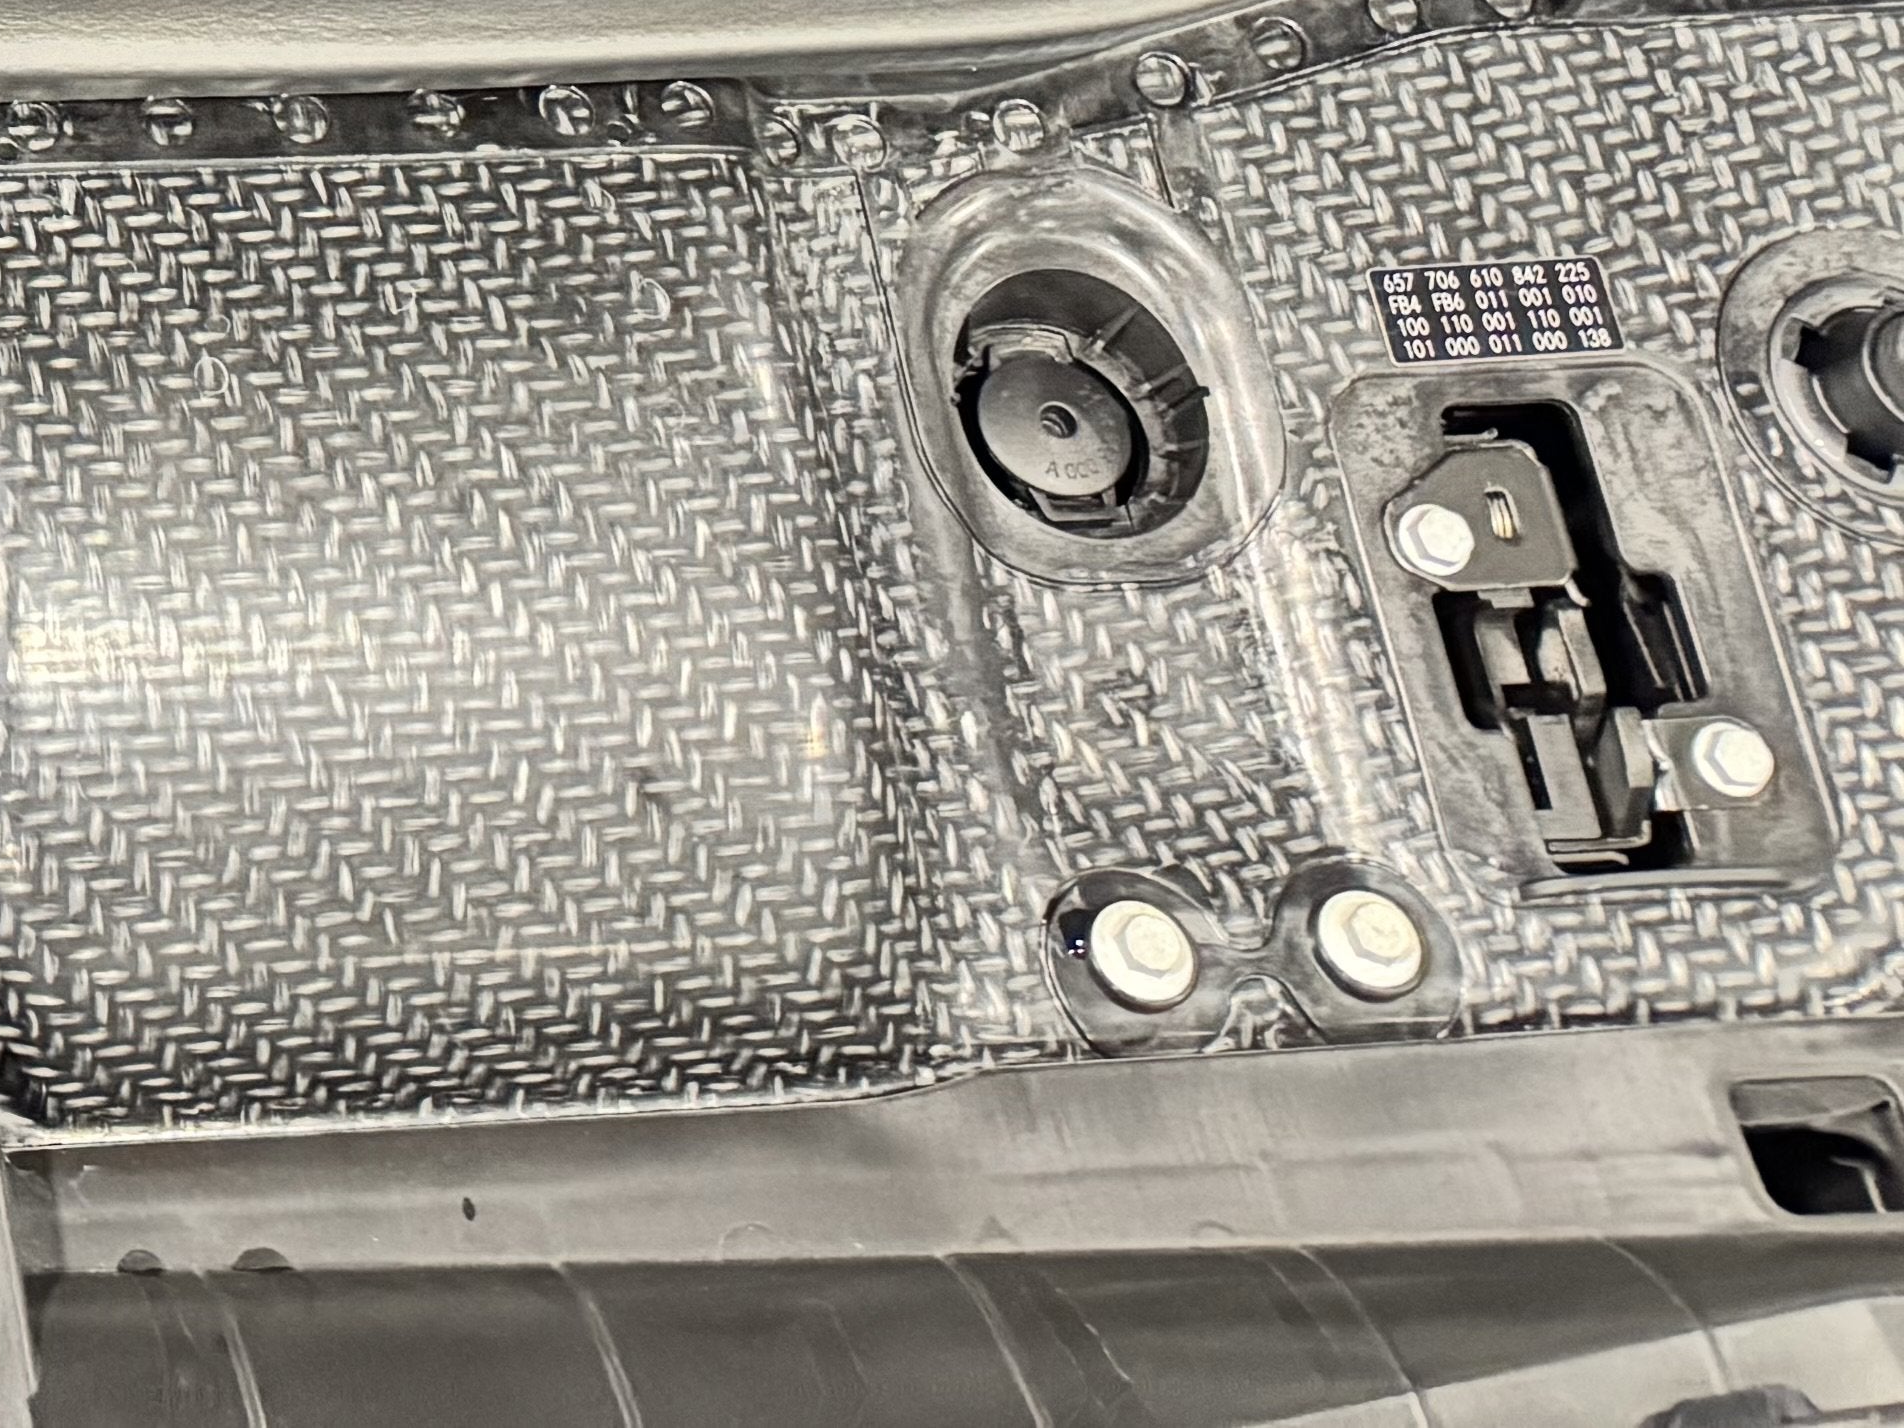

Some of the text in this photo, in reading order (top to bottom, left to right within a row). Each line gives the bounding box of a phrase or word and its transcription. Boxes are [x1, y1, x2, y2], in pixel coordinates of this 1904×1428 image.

[1383, 261, 1590, 293] 657 706 610 842 225
[1388, 284, 1597, 316] FB4 FB6 011 001 010
[1397, 306, 1603, 337] 100 110 001 110 001
[1403, 327, 1612, 359] 101 000 011 000 138
[1045, 460, 1059, 478] A
